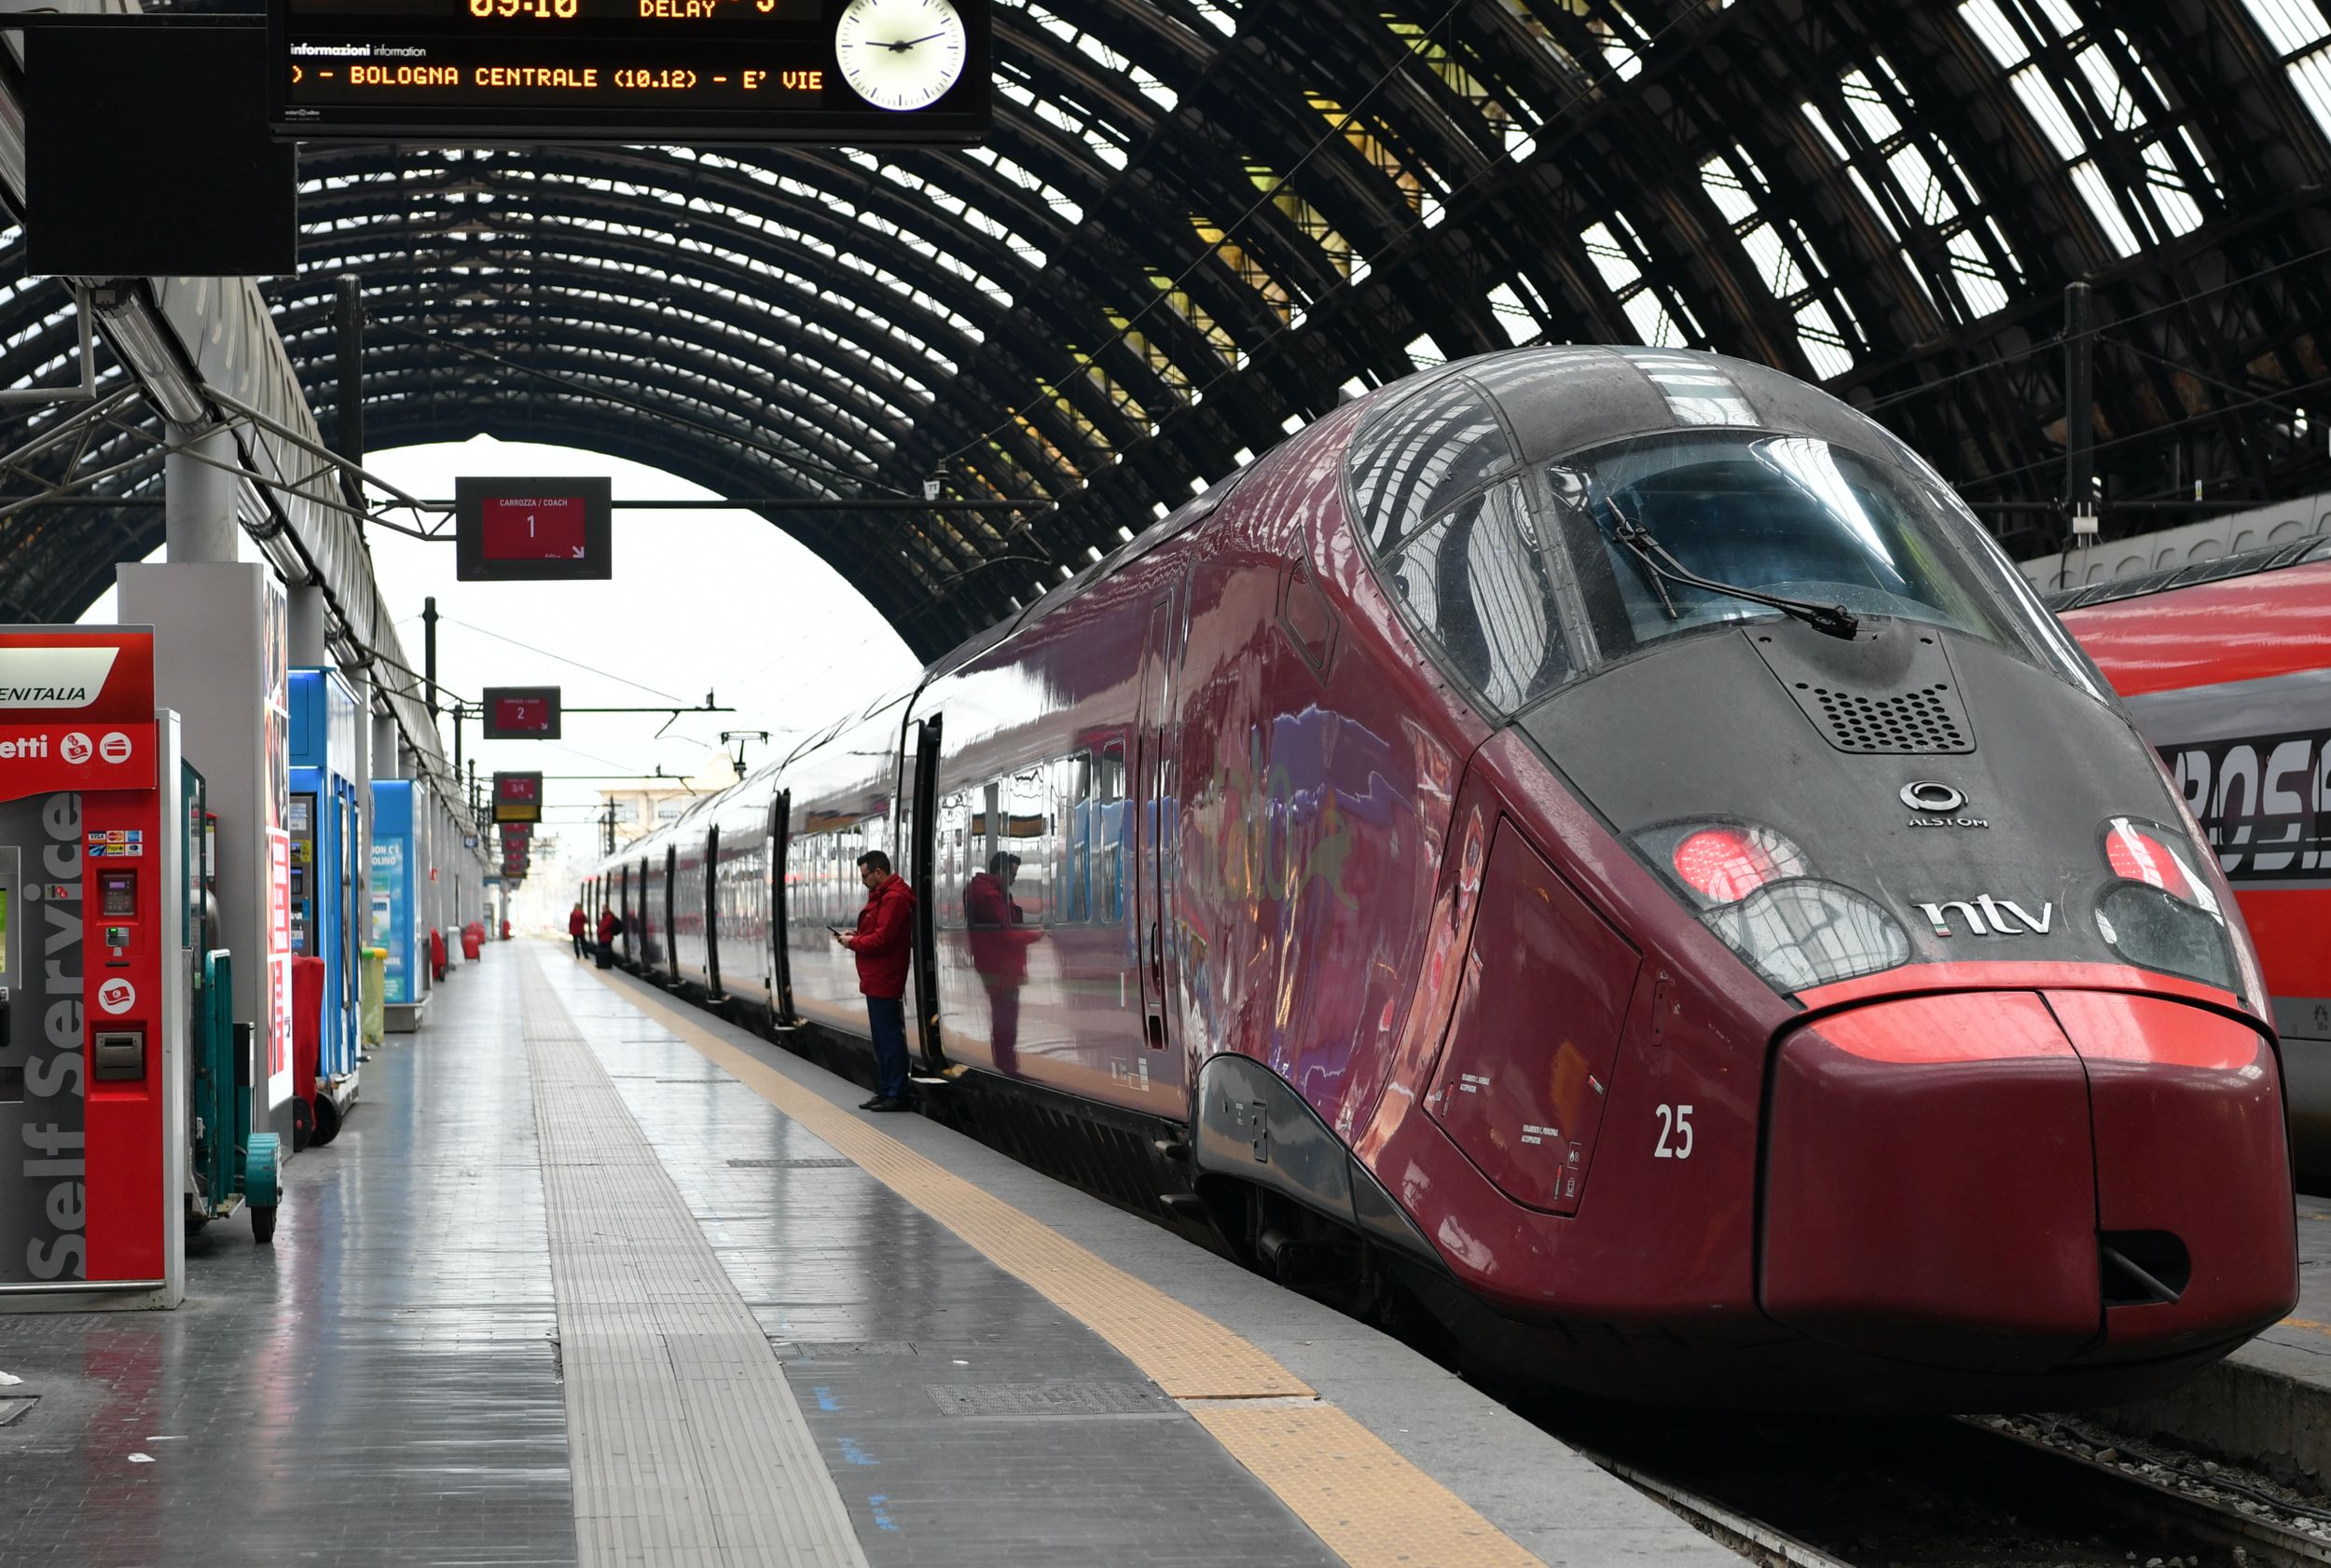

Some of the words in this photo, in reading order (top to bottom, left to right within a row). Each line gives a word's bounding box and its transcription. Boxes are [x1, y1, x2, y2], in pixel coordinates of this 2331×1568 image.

[640, 0, 716, 18] DELAY
[290, 43, 371, 57] informazioni
[373, 44, 427, 57] information
[351, 66, 459, 85] BOLOGNA
[476, 68, 598, 87] CENTRALE
[614, 69, 697, 89] (10.12)
[782, 72, 822, 89] VIE
[499, 499, 537, 507] CARROZZA
[543, 499, 568, 507] COACH
[527, 515, 534, 538] 1
[517, 707, 525, 720] 2
[1909, 818, 1989, 828] ALSTOM
[1912, 893, 2052, 937] ntv
[23, 791, 85, 1099] Service
[1654, 1104, 1693, 1159] 25
[22, 1122, 86, 1281] Self
